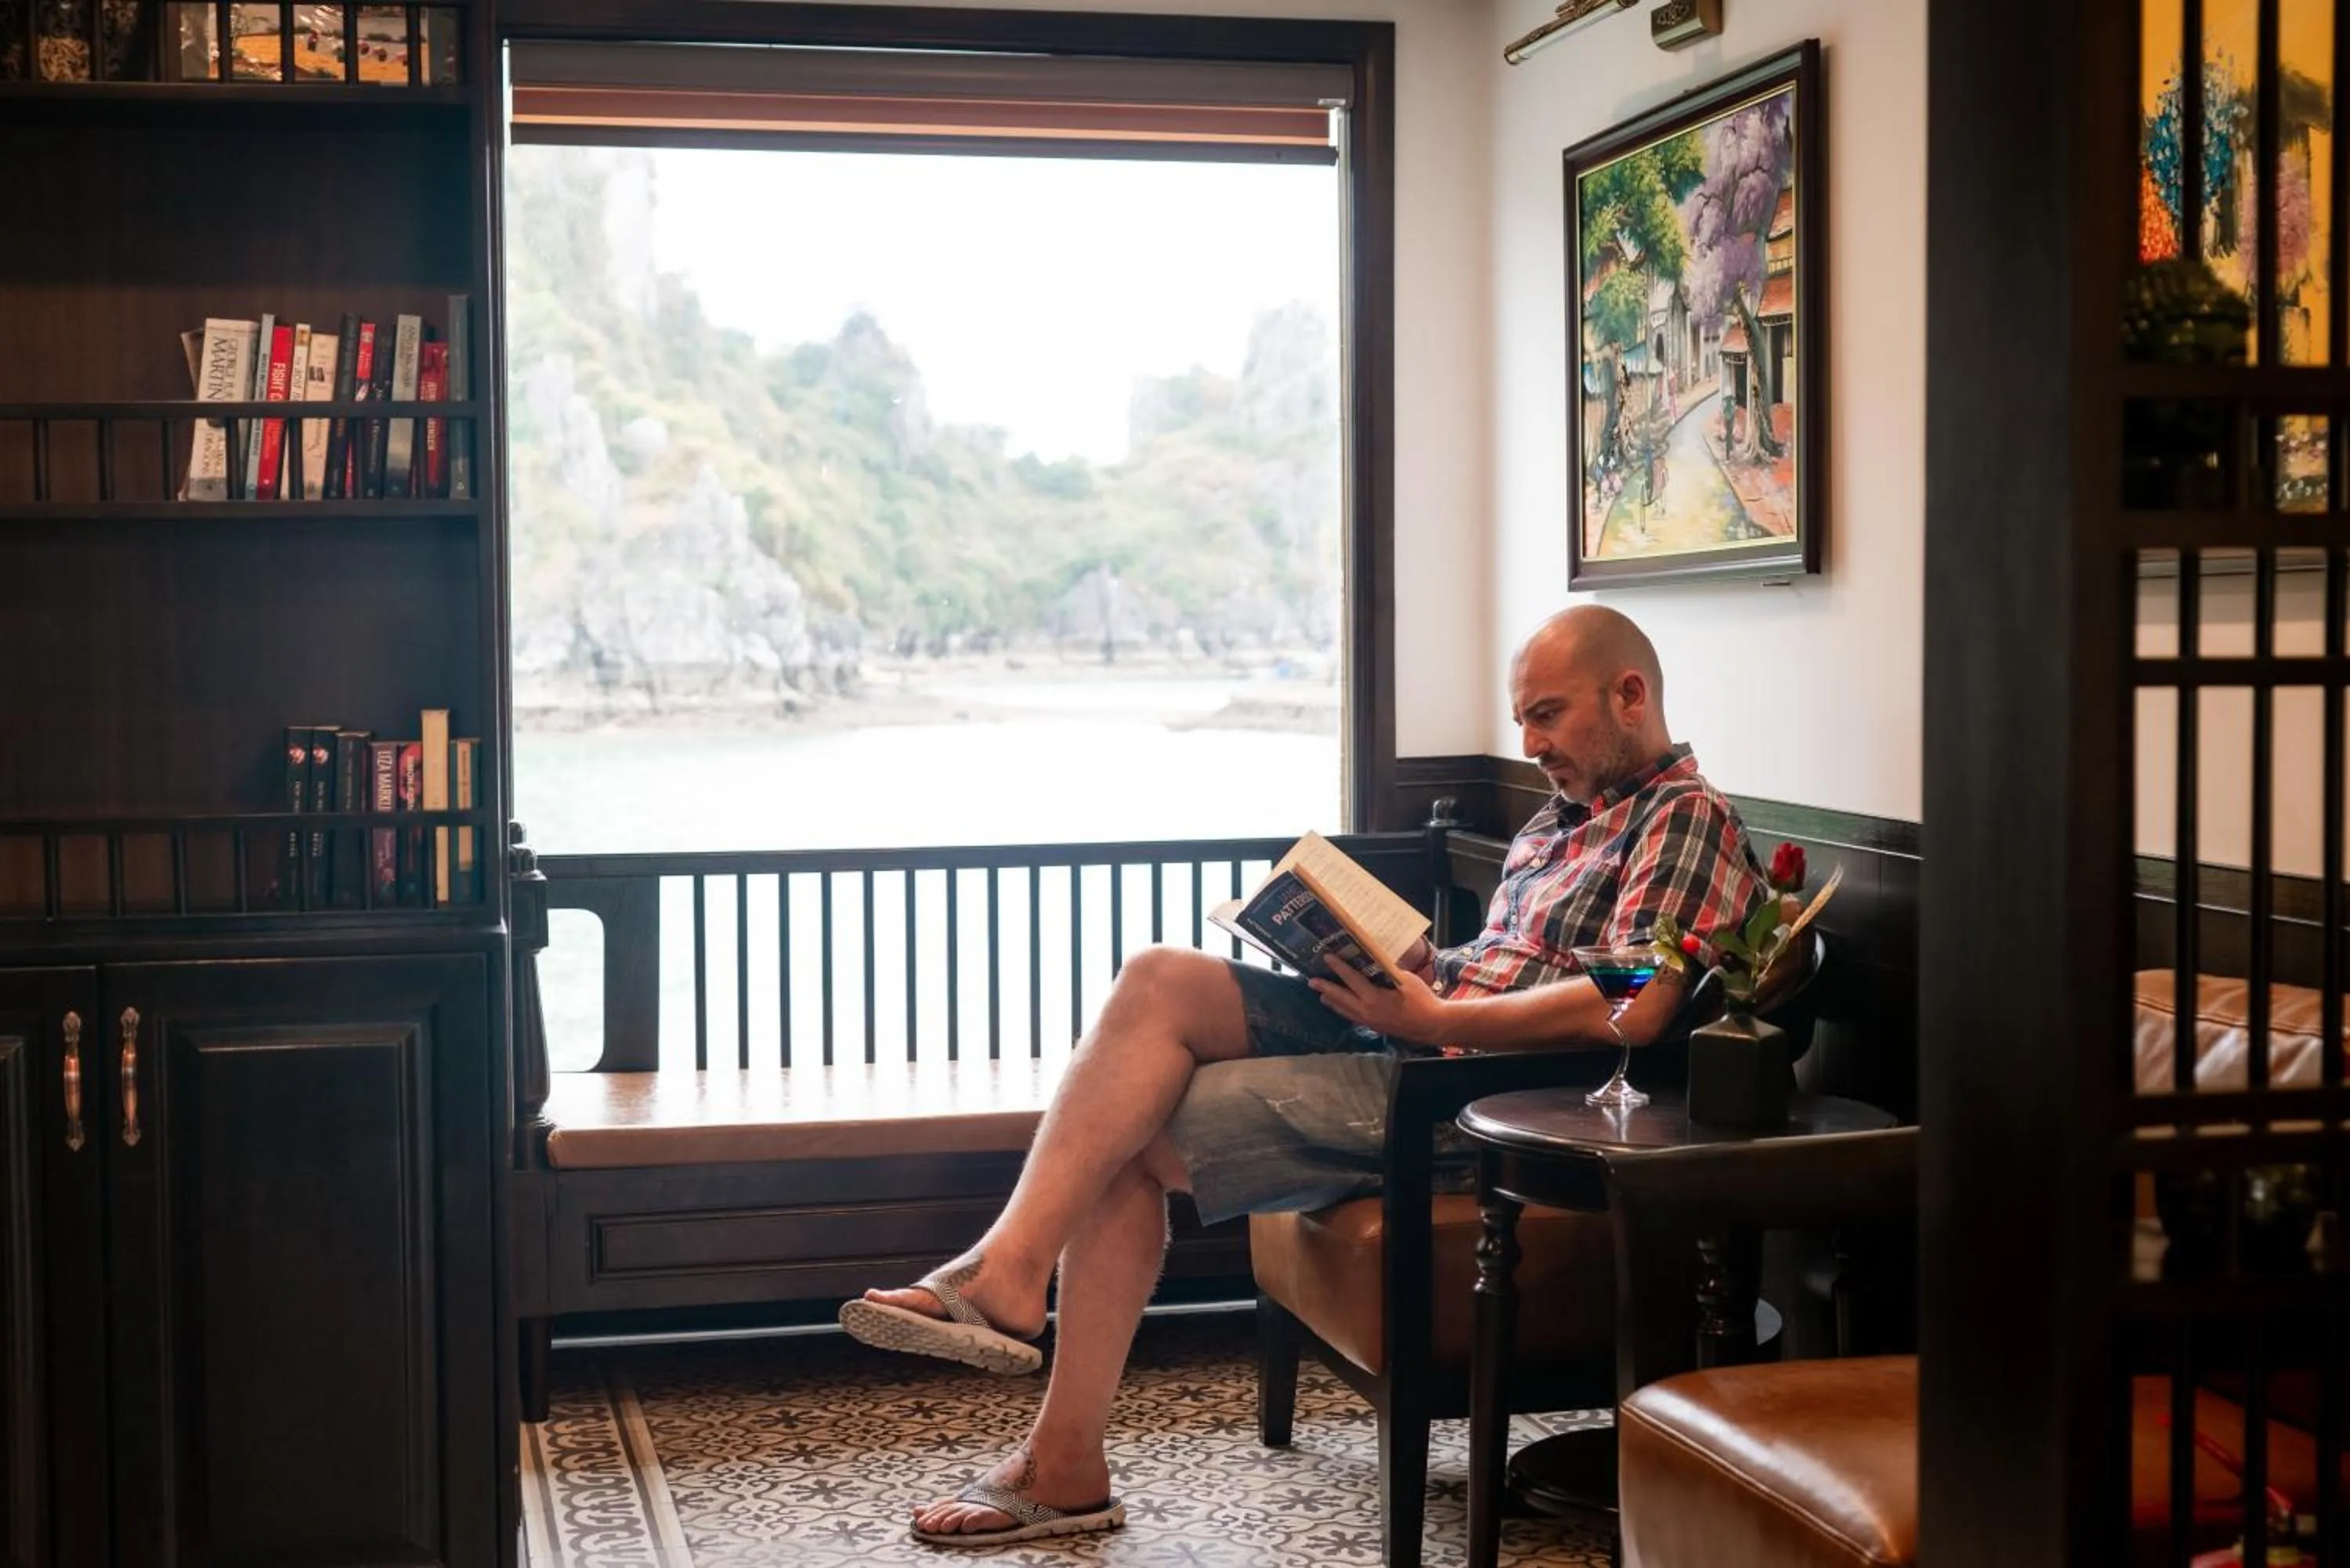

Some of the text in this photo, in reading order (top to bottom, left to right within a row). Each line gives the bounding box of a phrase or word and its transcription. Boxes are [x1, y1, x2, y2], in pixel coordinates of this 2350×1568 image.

[207, 336, 228, 400] MARTIN
[269, 363, 286, 392] FIGHT
[377, 750, 392, 772] LIZA
